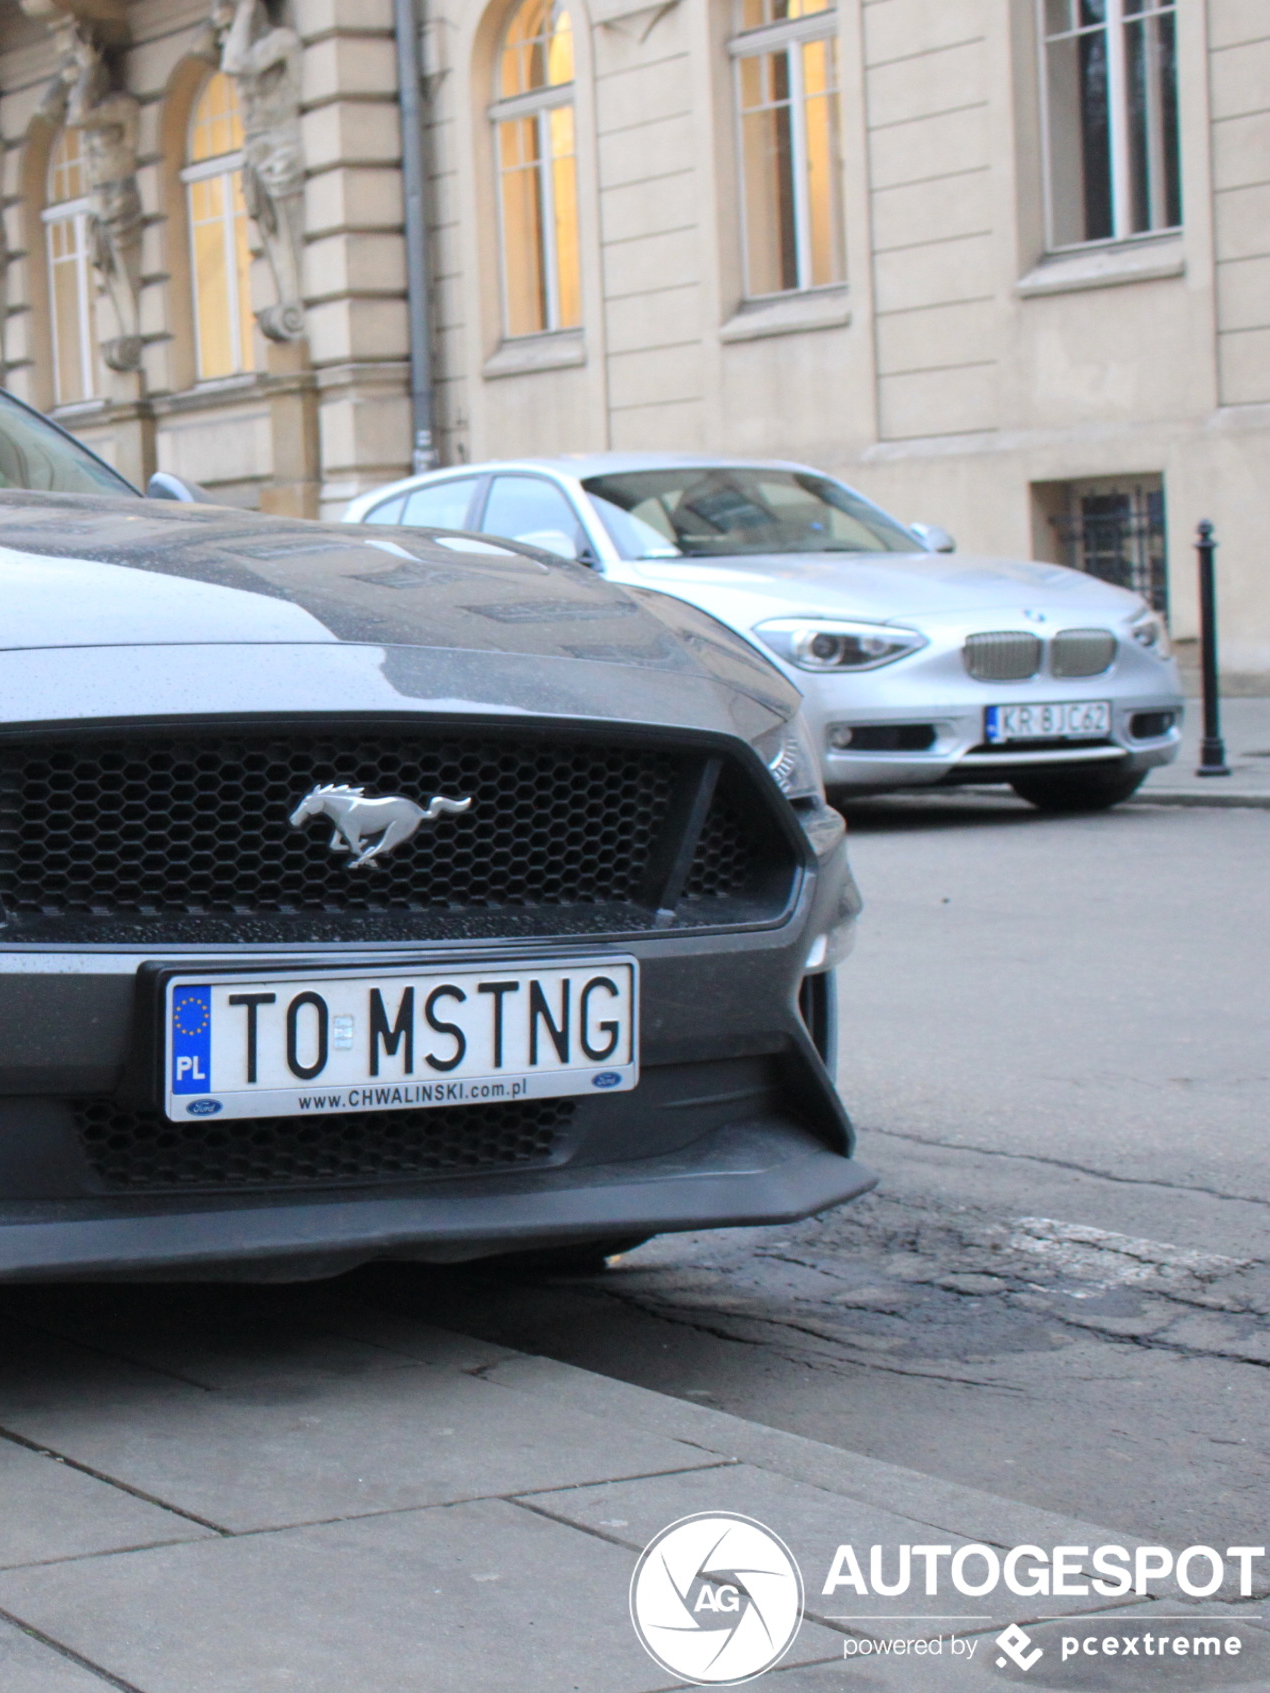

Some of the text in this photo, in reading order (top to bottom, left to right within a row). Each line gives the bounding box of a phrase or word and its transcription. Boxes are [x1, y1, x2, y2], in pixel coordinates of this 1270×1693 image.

[1001, 704, 1105, 733] KR 8JC62
[228, 975, 621, 1084] TO MSTNG
[176, 1055, 206, 1081] PL
[298, 1079, 528, 1110] www.CHWALINSKI.com.pl
